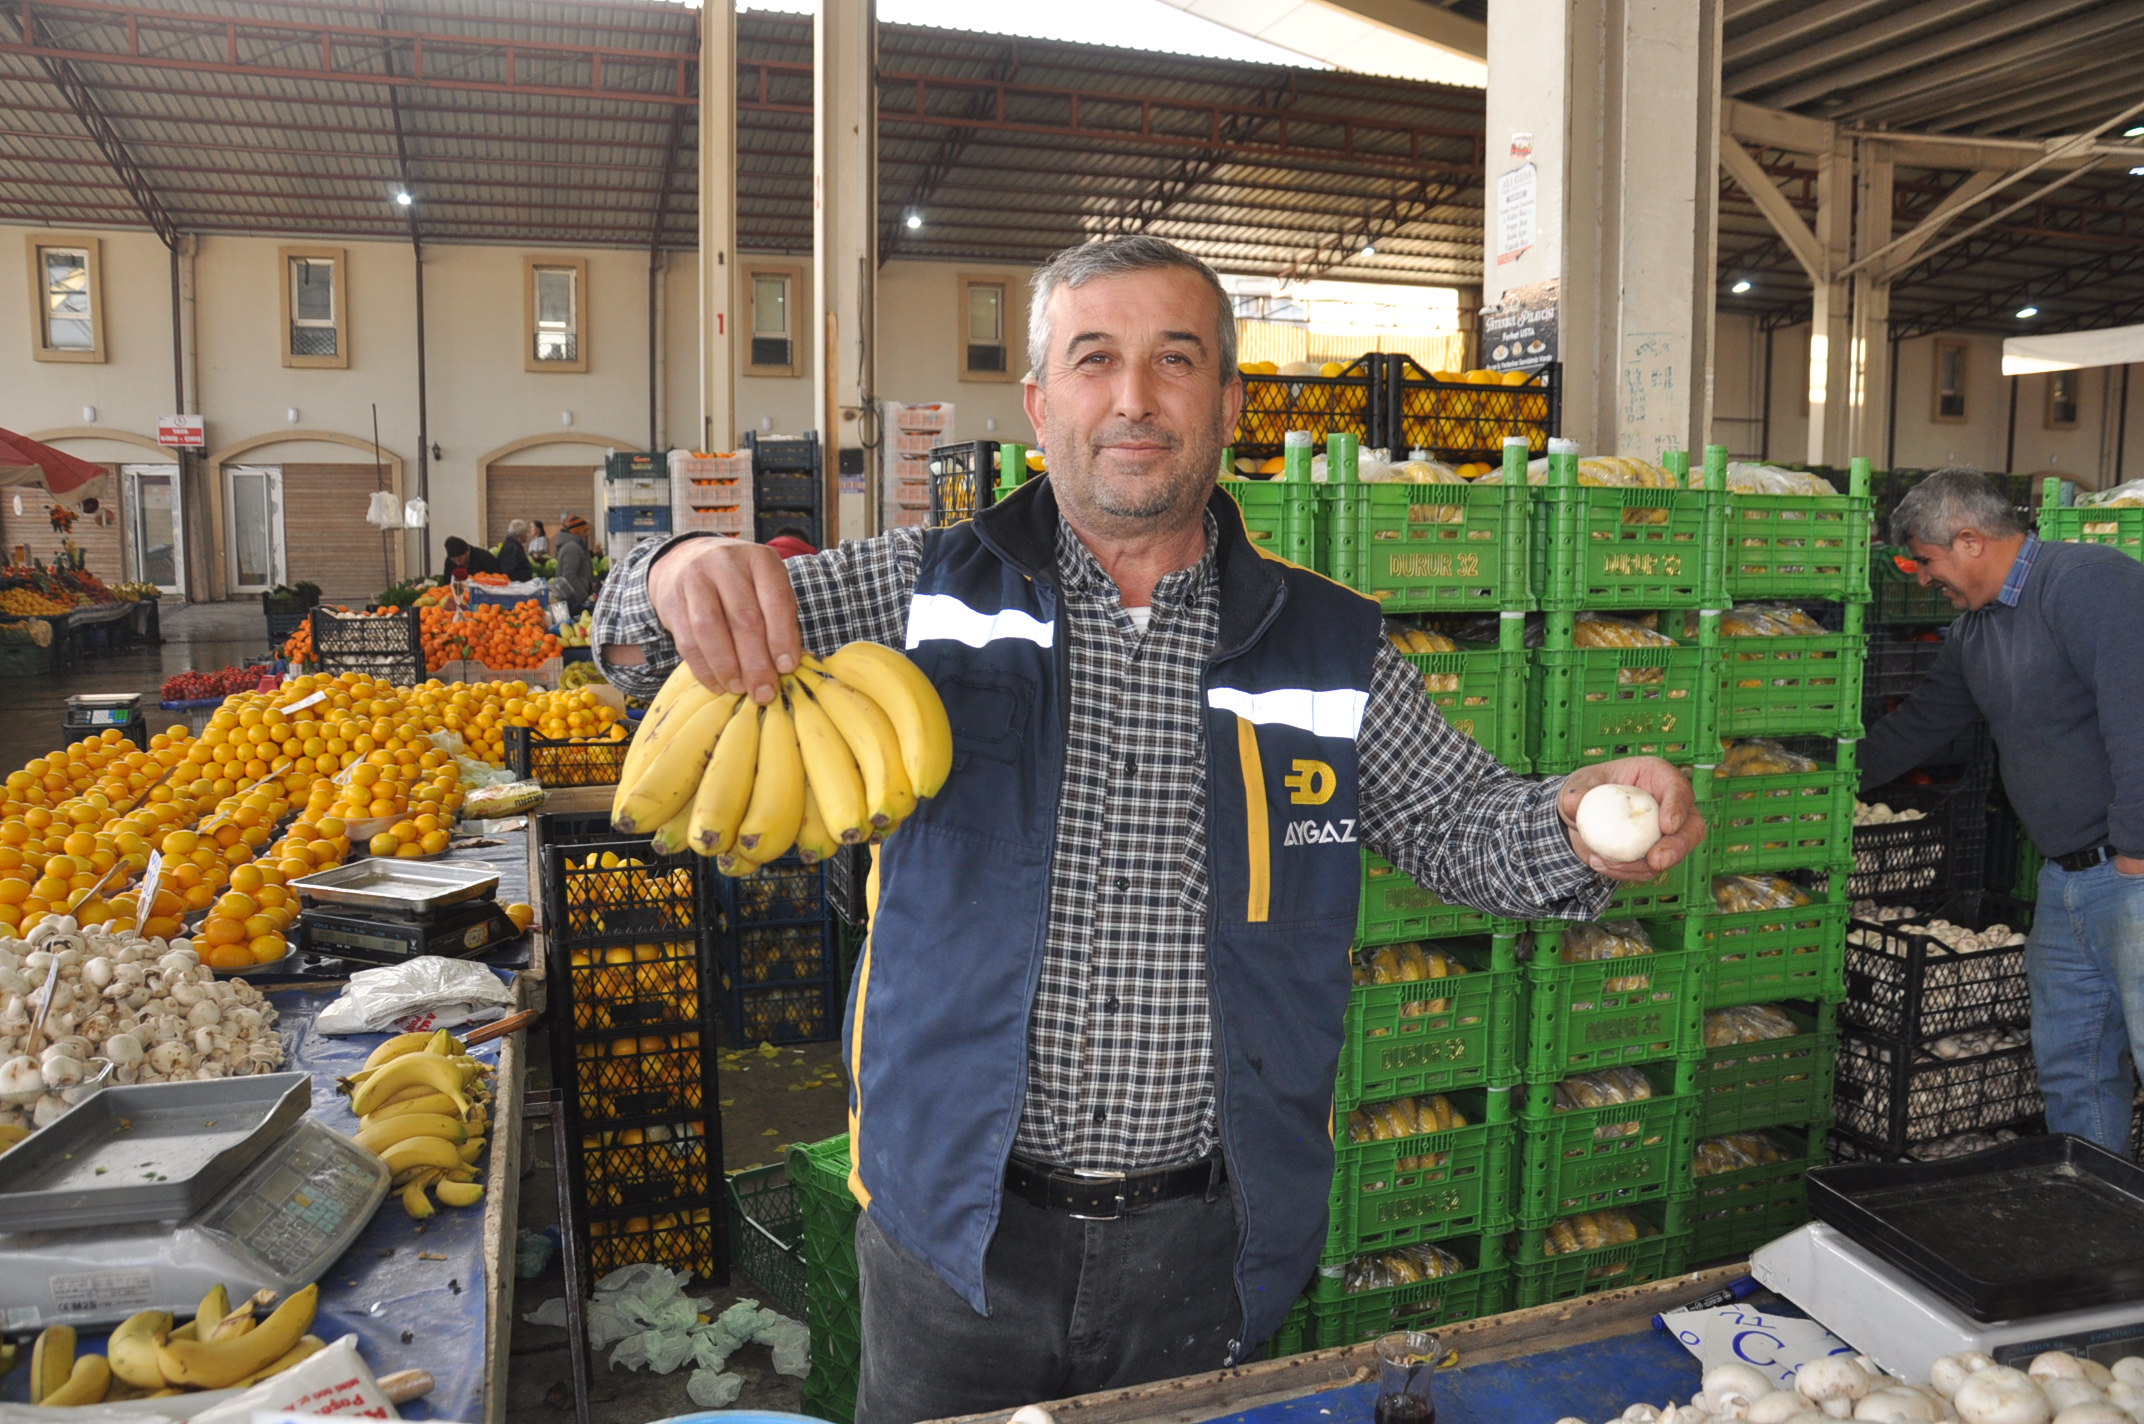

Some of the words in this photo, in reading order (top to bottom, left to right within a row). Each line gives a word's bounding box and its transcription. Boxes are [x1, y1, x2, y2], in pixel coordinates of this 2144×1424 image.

[1389, 553, 1452, 577] DURUR
[1457, 553, 1479, 577] 32
[1603, 553, 1658, 576] DURUR
[1662, 553, 1682, 576] 32
[1284, 819, 1357, 846] AYGAZ
[1446, 1037, 1465, 1060] 32
